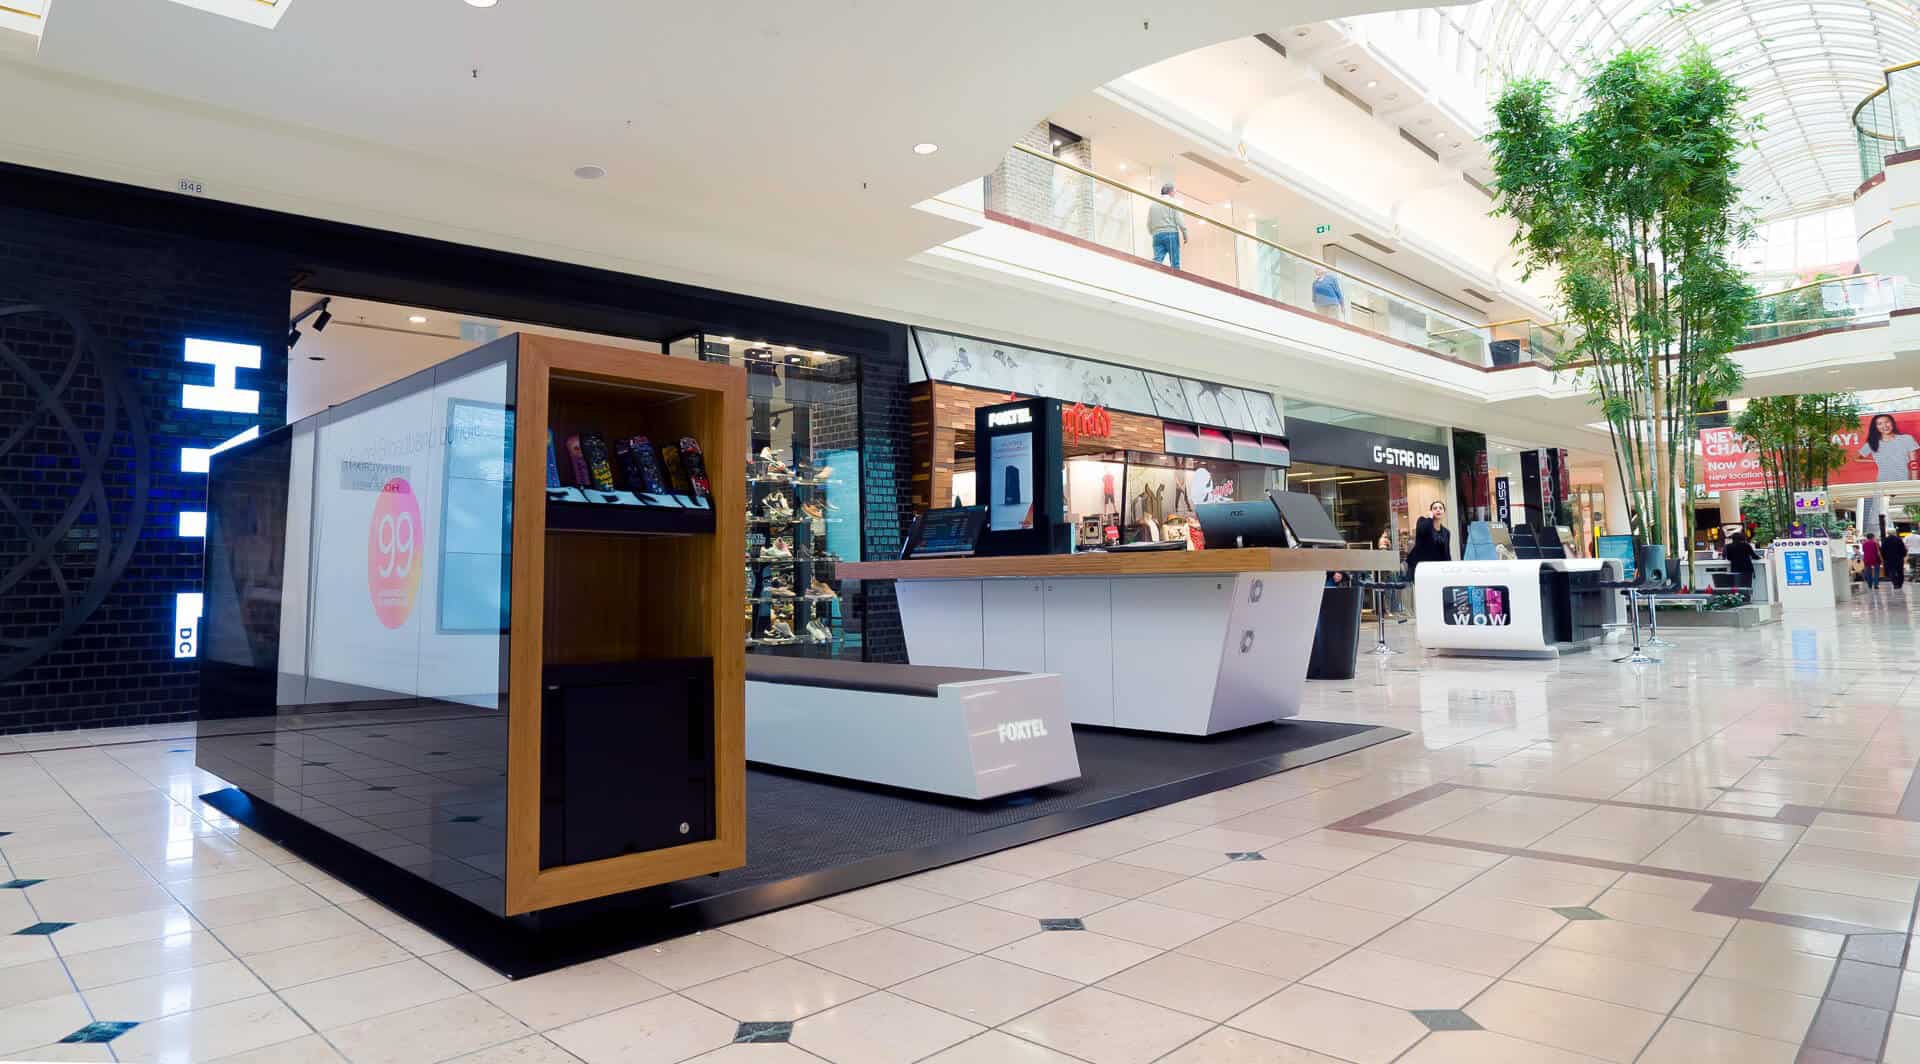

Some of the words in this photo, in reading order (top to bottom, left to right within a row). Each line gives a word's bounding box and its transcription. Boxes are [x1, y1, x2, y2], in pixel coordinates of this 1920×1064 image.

[988, 407, 1033, 428] FOXTEL
[1373, 445, 1415, 469] G-STAR
[1416, 452, 1440, 471] RAW
[1708, 461, 1737, 471] Now
[1796, 497, 1825, 508] dodo
[1453, 613, 1508, 626] WOW
[178, 627, 193, 655] DC
[999, 717, 1049, 744] FOXTEL
